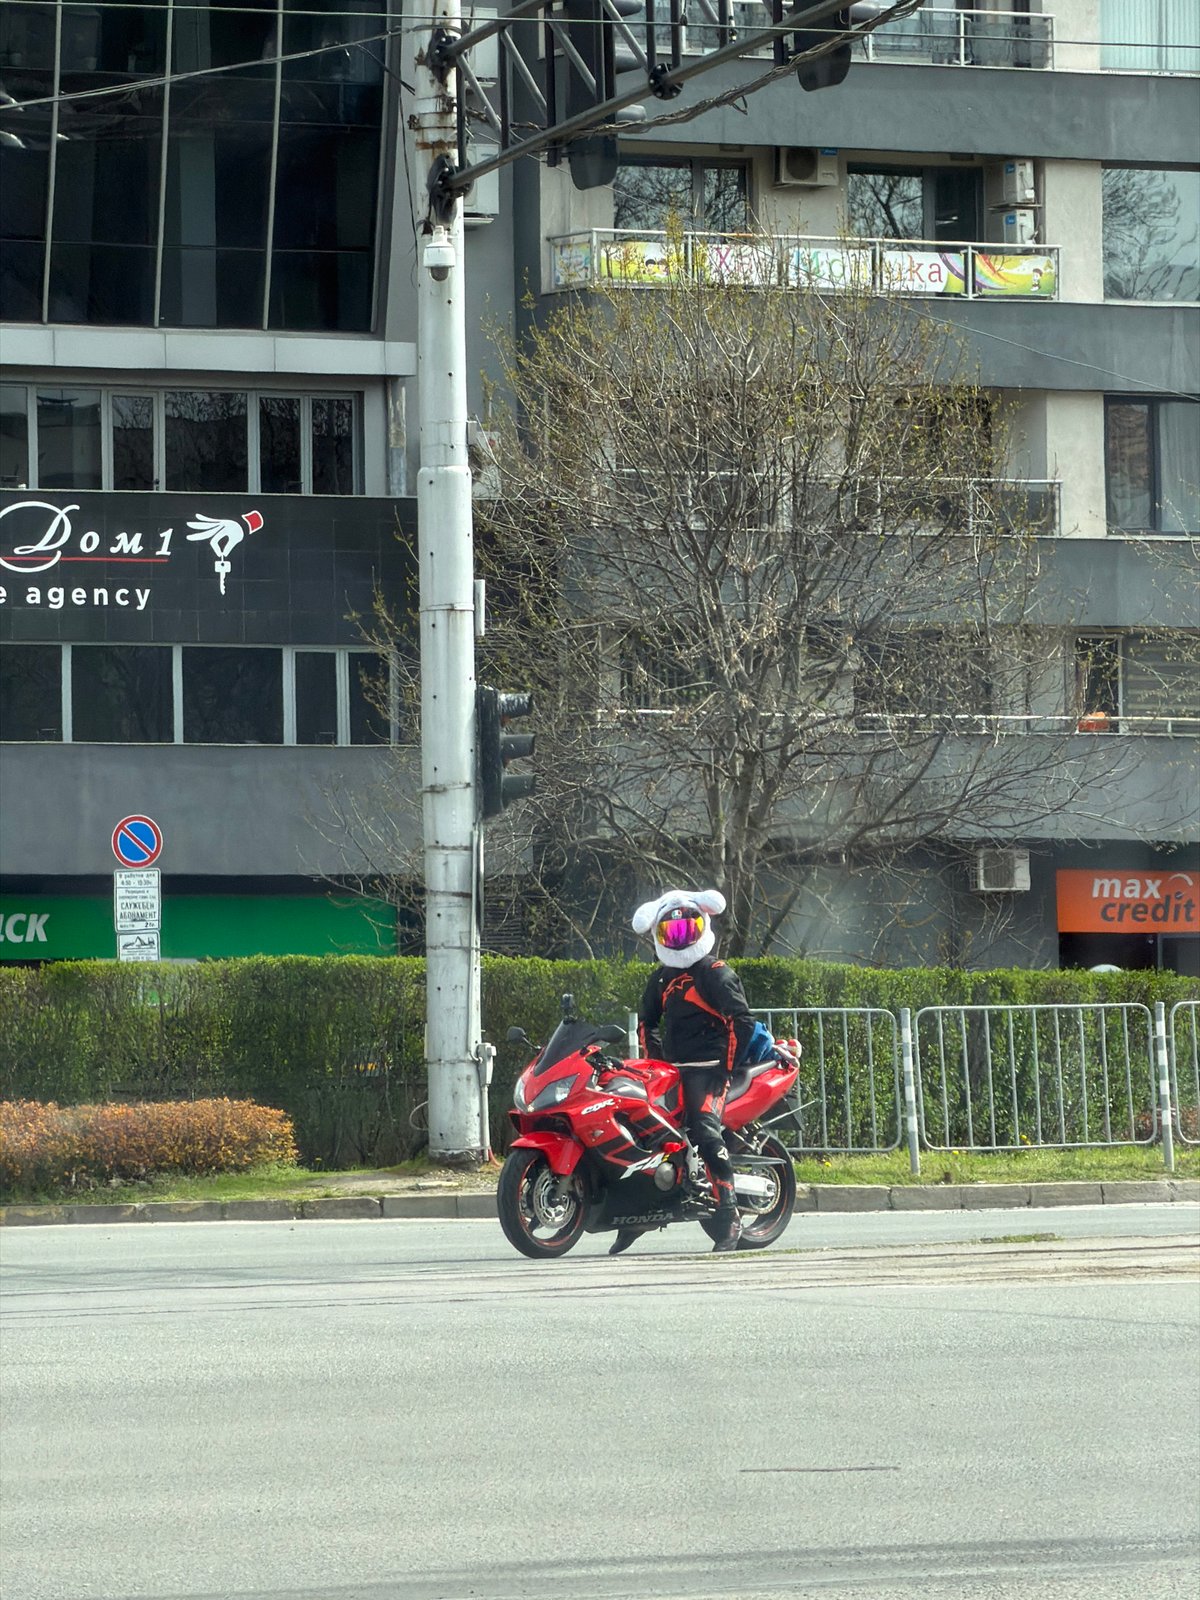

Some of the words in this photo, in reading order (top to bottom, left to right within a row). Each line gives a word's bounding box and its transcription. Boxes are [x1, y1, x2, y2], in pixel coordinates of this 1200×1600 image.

[25, 586, 151, 610] agency
[1091, 877, 1162, 899] max
[120, 901, 155, 910] СЛУЖЕБЕН
[1100, 891, 1196, 923] credit
[119, 911, 157, 920] АБОНАМЕНТ
[611, 1212, 674, 1225] HONDA
